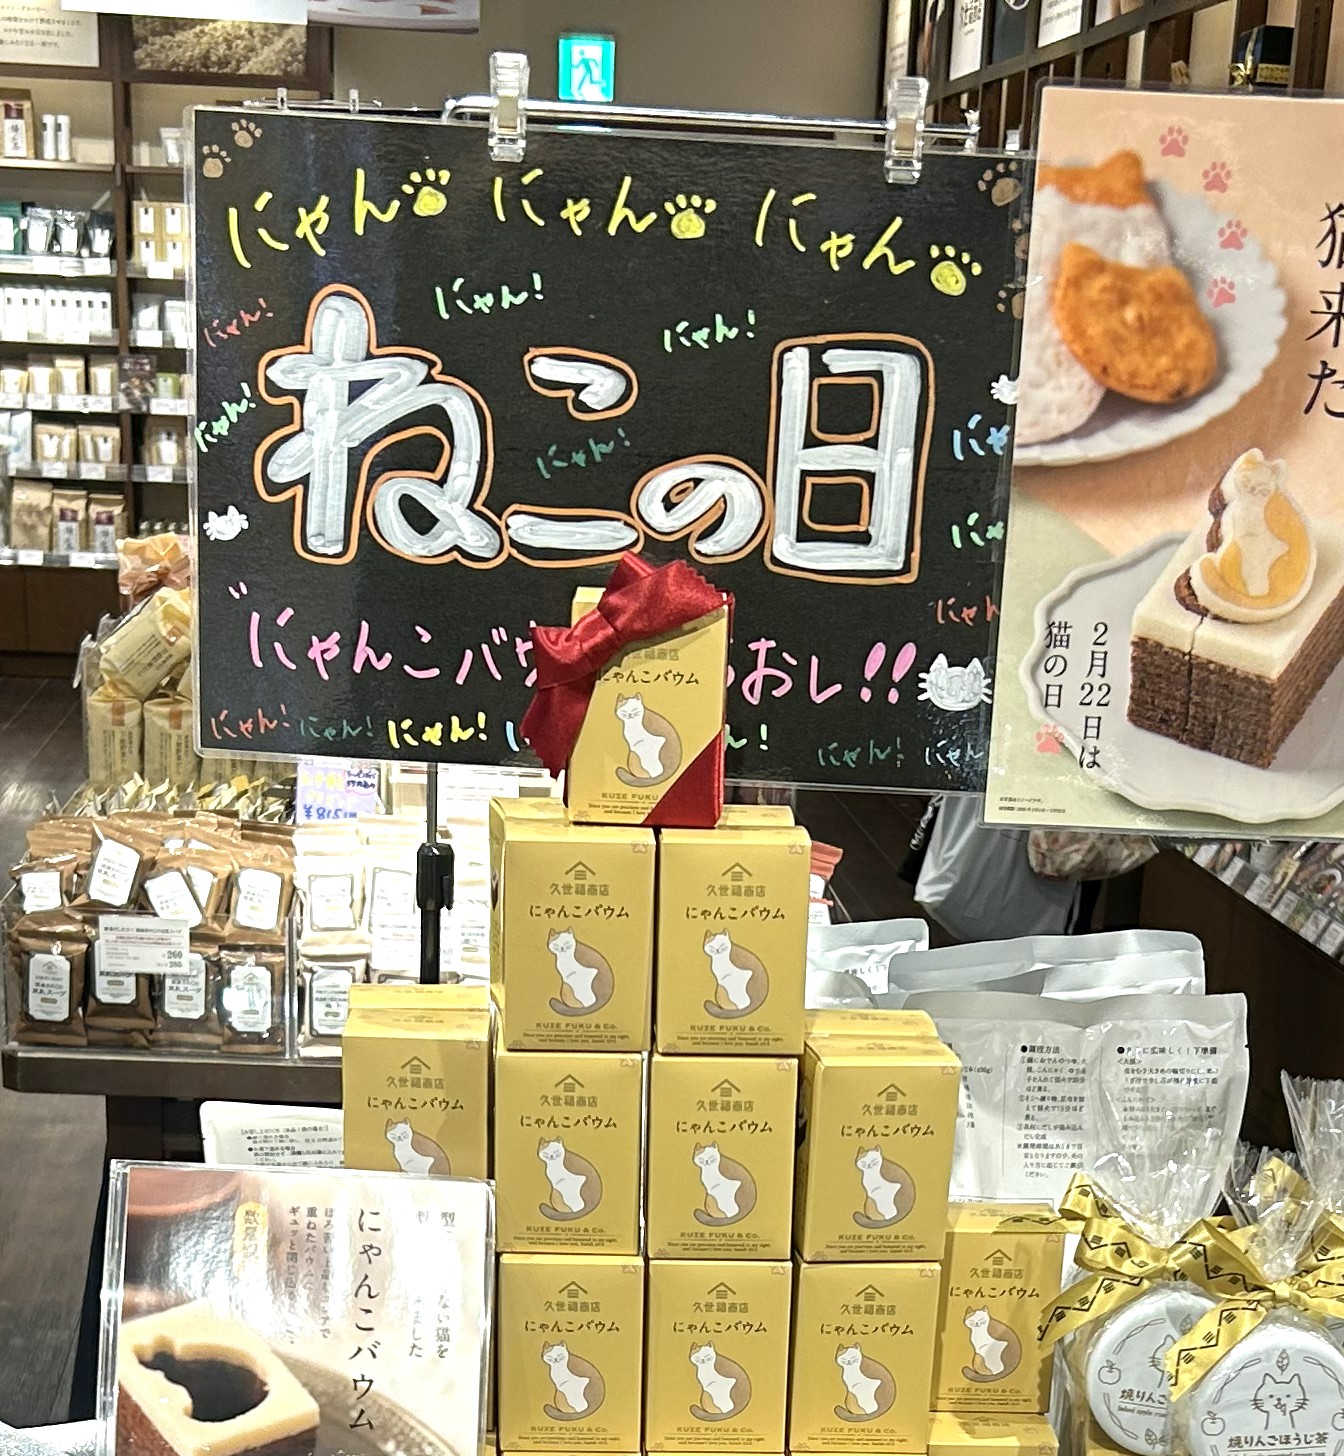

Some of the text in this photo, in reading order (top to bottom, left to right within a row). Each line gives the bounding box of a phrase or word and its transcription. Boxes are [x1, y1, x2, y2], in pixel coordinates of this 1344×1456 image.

[229, 168, 916, 275] にゃん にゃん にゃん
[435, 273, 544, 320] にゃん!
[662, 309, 756, 353] にゃん!
[255, 284, 935, 586] ねこの日
[1043, 620, 1073, 709] 猫の日
[1078, 621, 1112, 770] 2月22日は
[387, 711, 488, 749] にゃん!
[528, 904, 630, 920] にゃんこバウム
[684, 905, 786, 921] にゃんこバウム
[366, 1095, 464, 1112] にゃんこバウム
[519, 1114, 618, 1130] にゃんこバウム
[675, 1120, 774, 1135] にゃんこバウム
[840, 1123, 935, 1138] にゃんこバウム
[949, 1285, 1040, 1300] にゃんこバウム
[347, 1207, 383, 1433] にゃんこバウム
[524, 1319, 621, 1334] にゃんこバウム
[673, 1320, 768, 1335] にゃんこバウム
[819, 1322, 914, 1337] にゃんこバウム
[1226, 1431, 1330, 1448] 焼りんごほうじ茶
